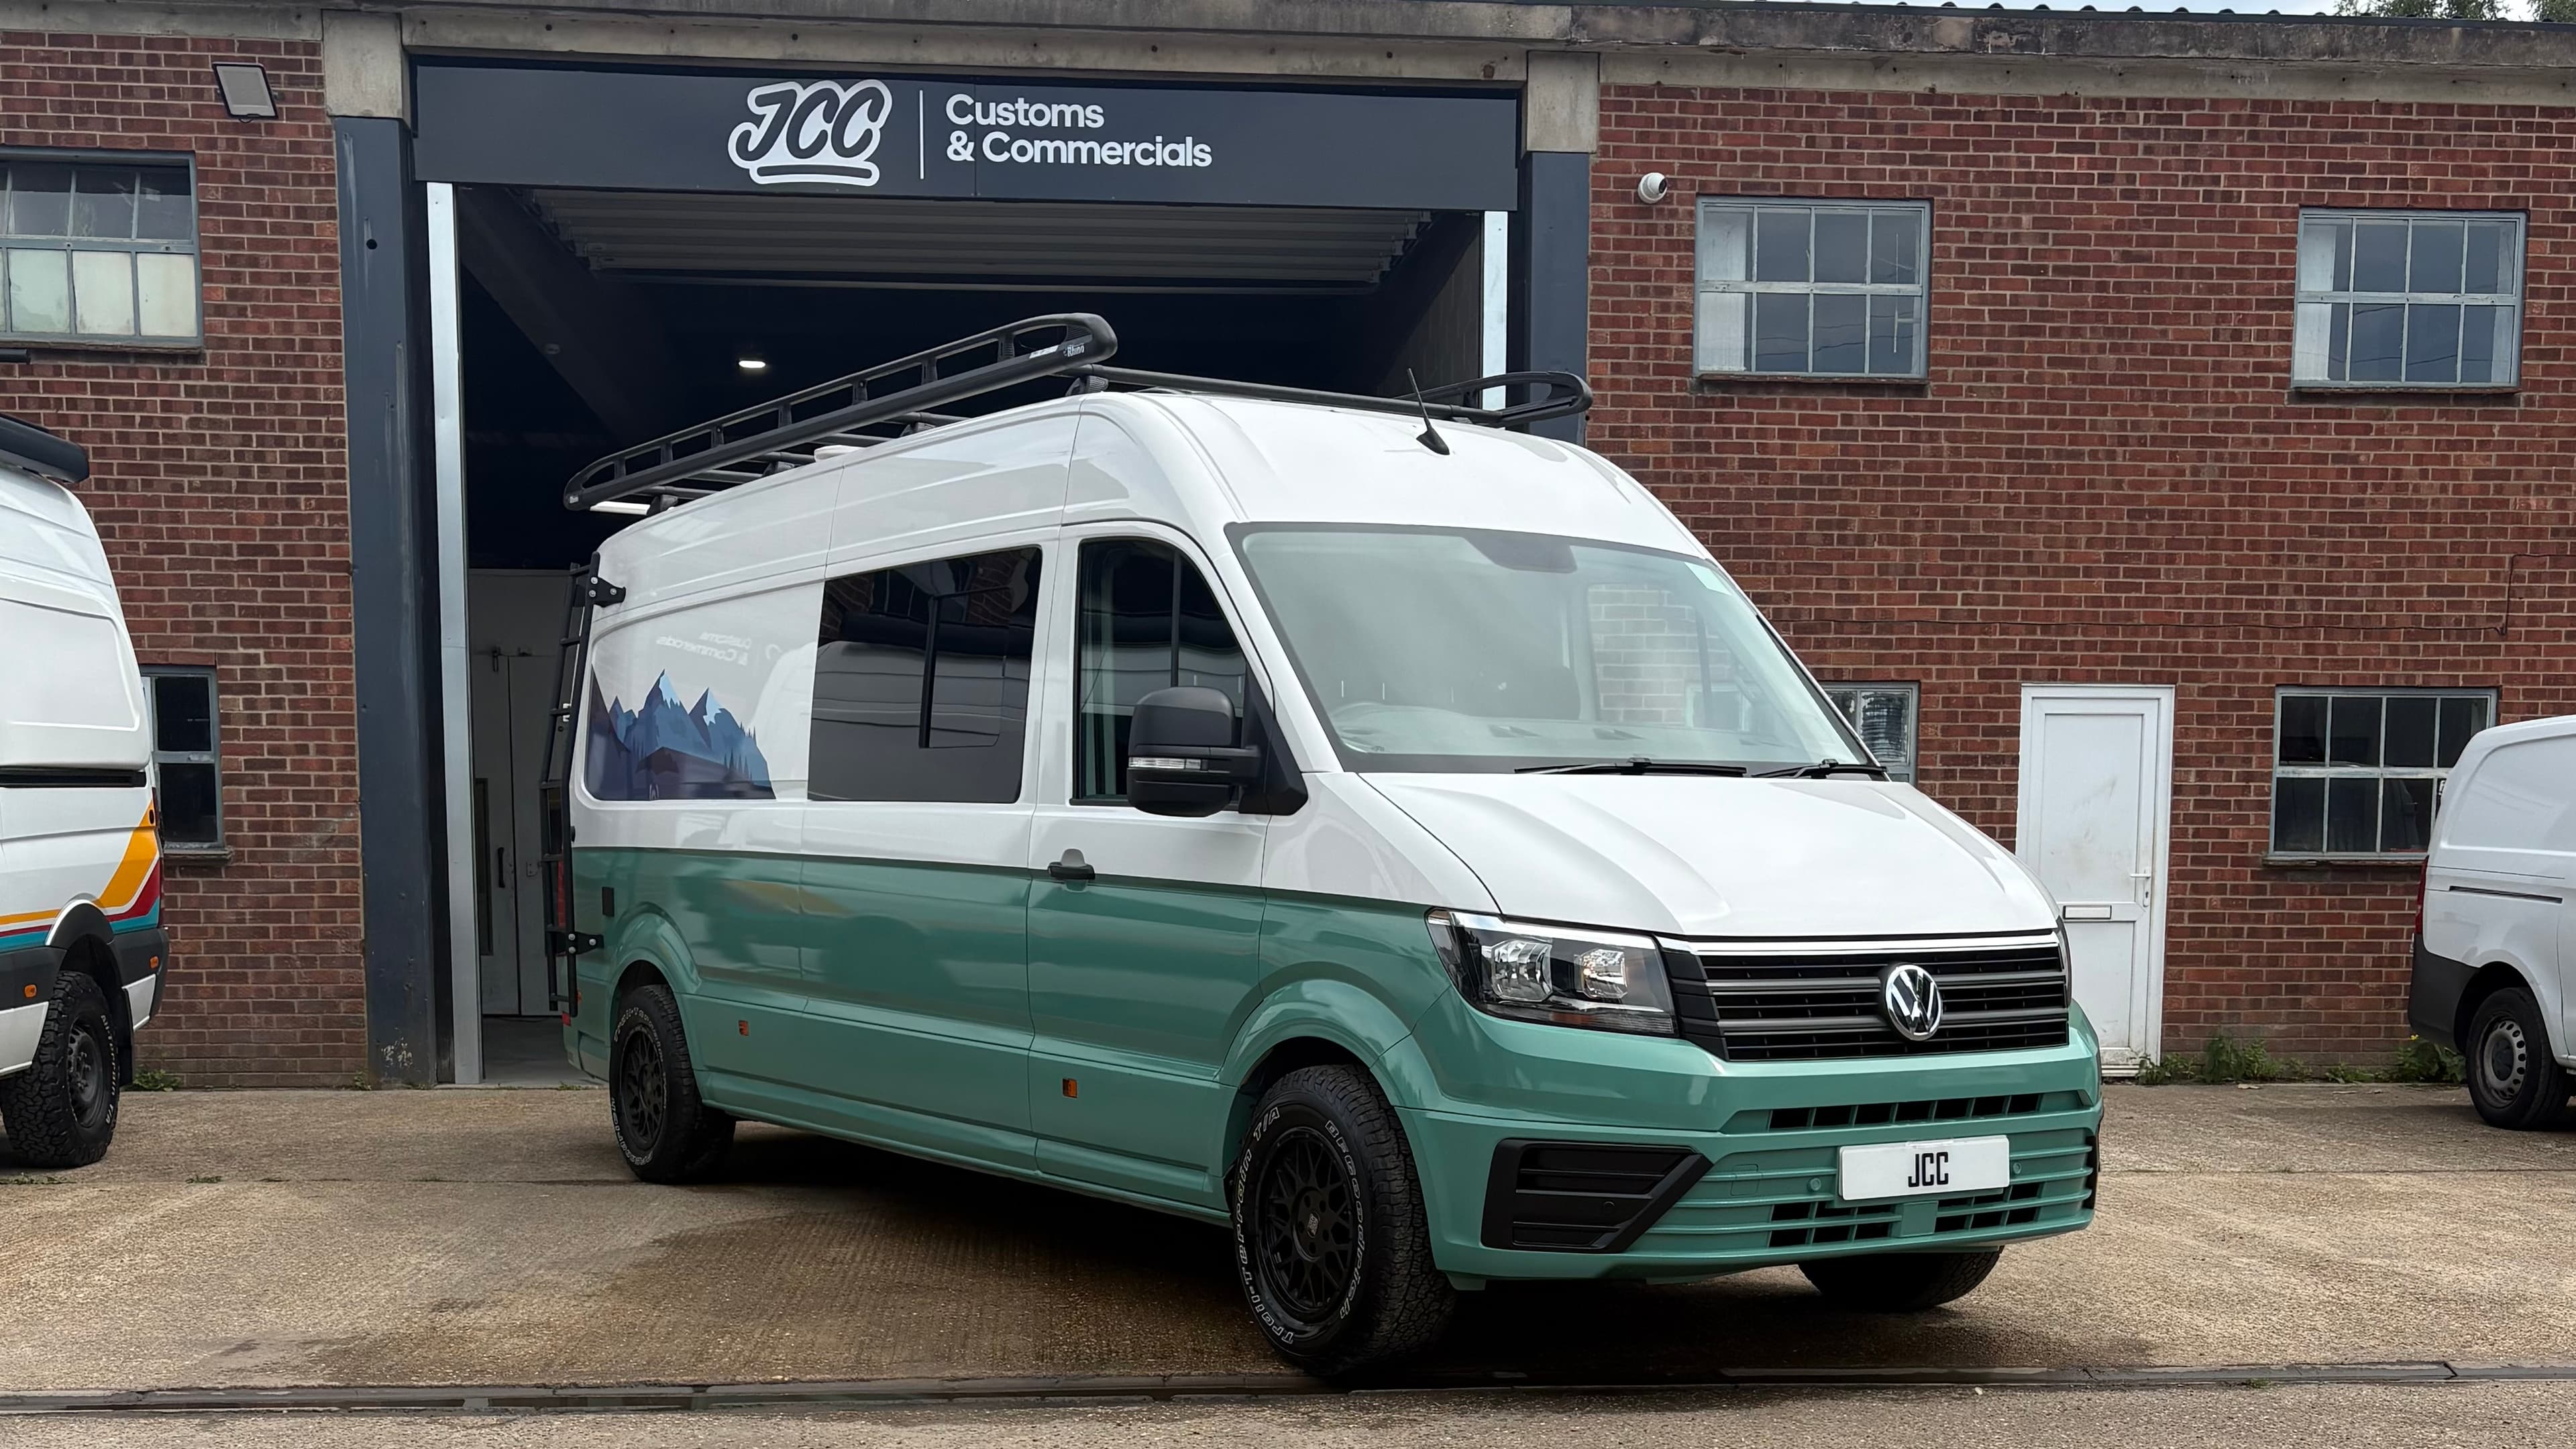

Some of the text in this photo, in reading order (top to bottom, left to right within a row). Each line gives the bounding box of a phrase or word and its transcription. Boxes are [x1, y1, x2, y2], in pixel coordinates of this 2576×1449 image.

[729, 80, 892, 176] JCC
[946, 93, 1104, 128] Customs
[946, 132, 1213, 168] & Commercials
[1907, 1151, 1949, 1188] JCC
[1236, 1106, 1295, 1344] Trail-Terrain T/A
